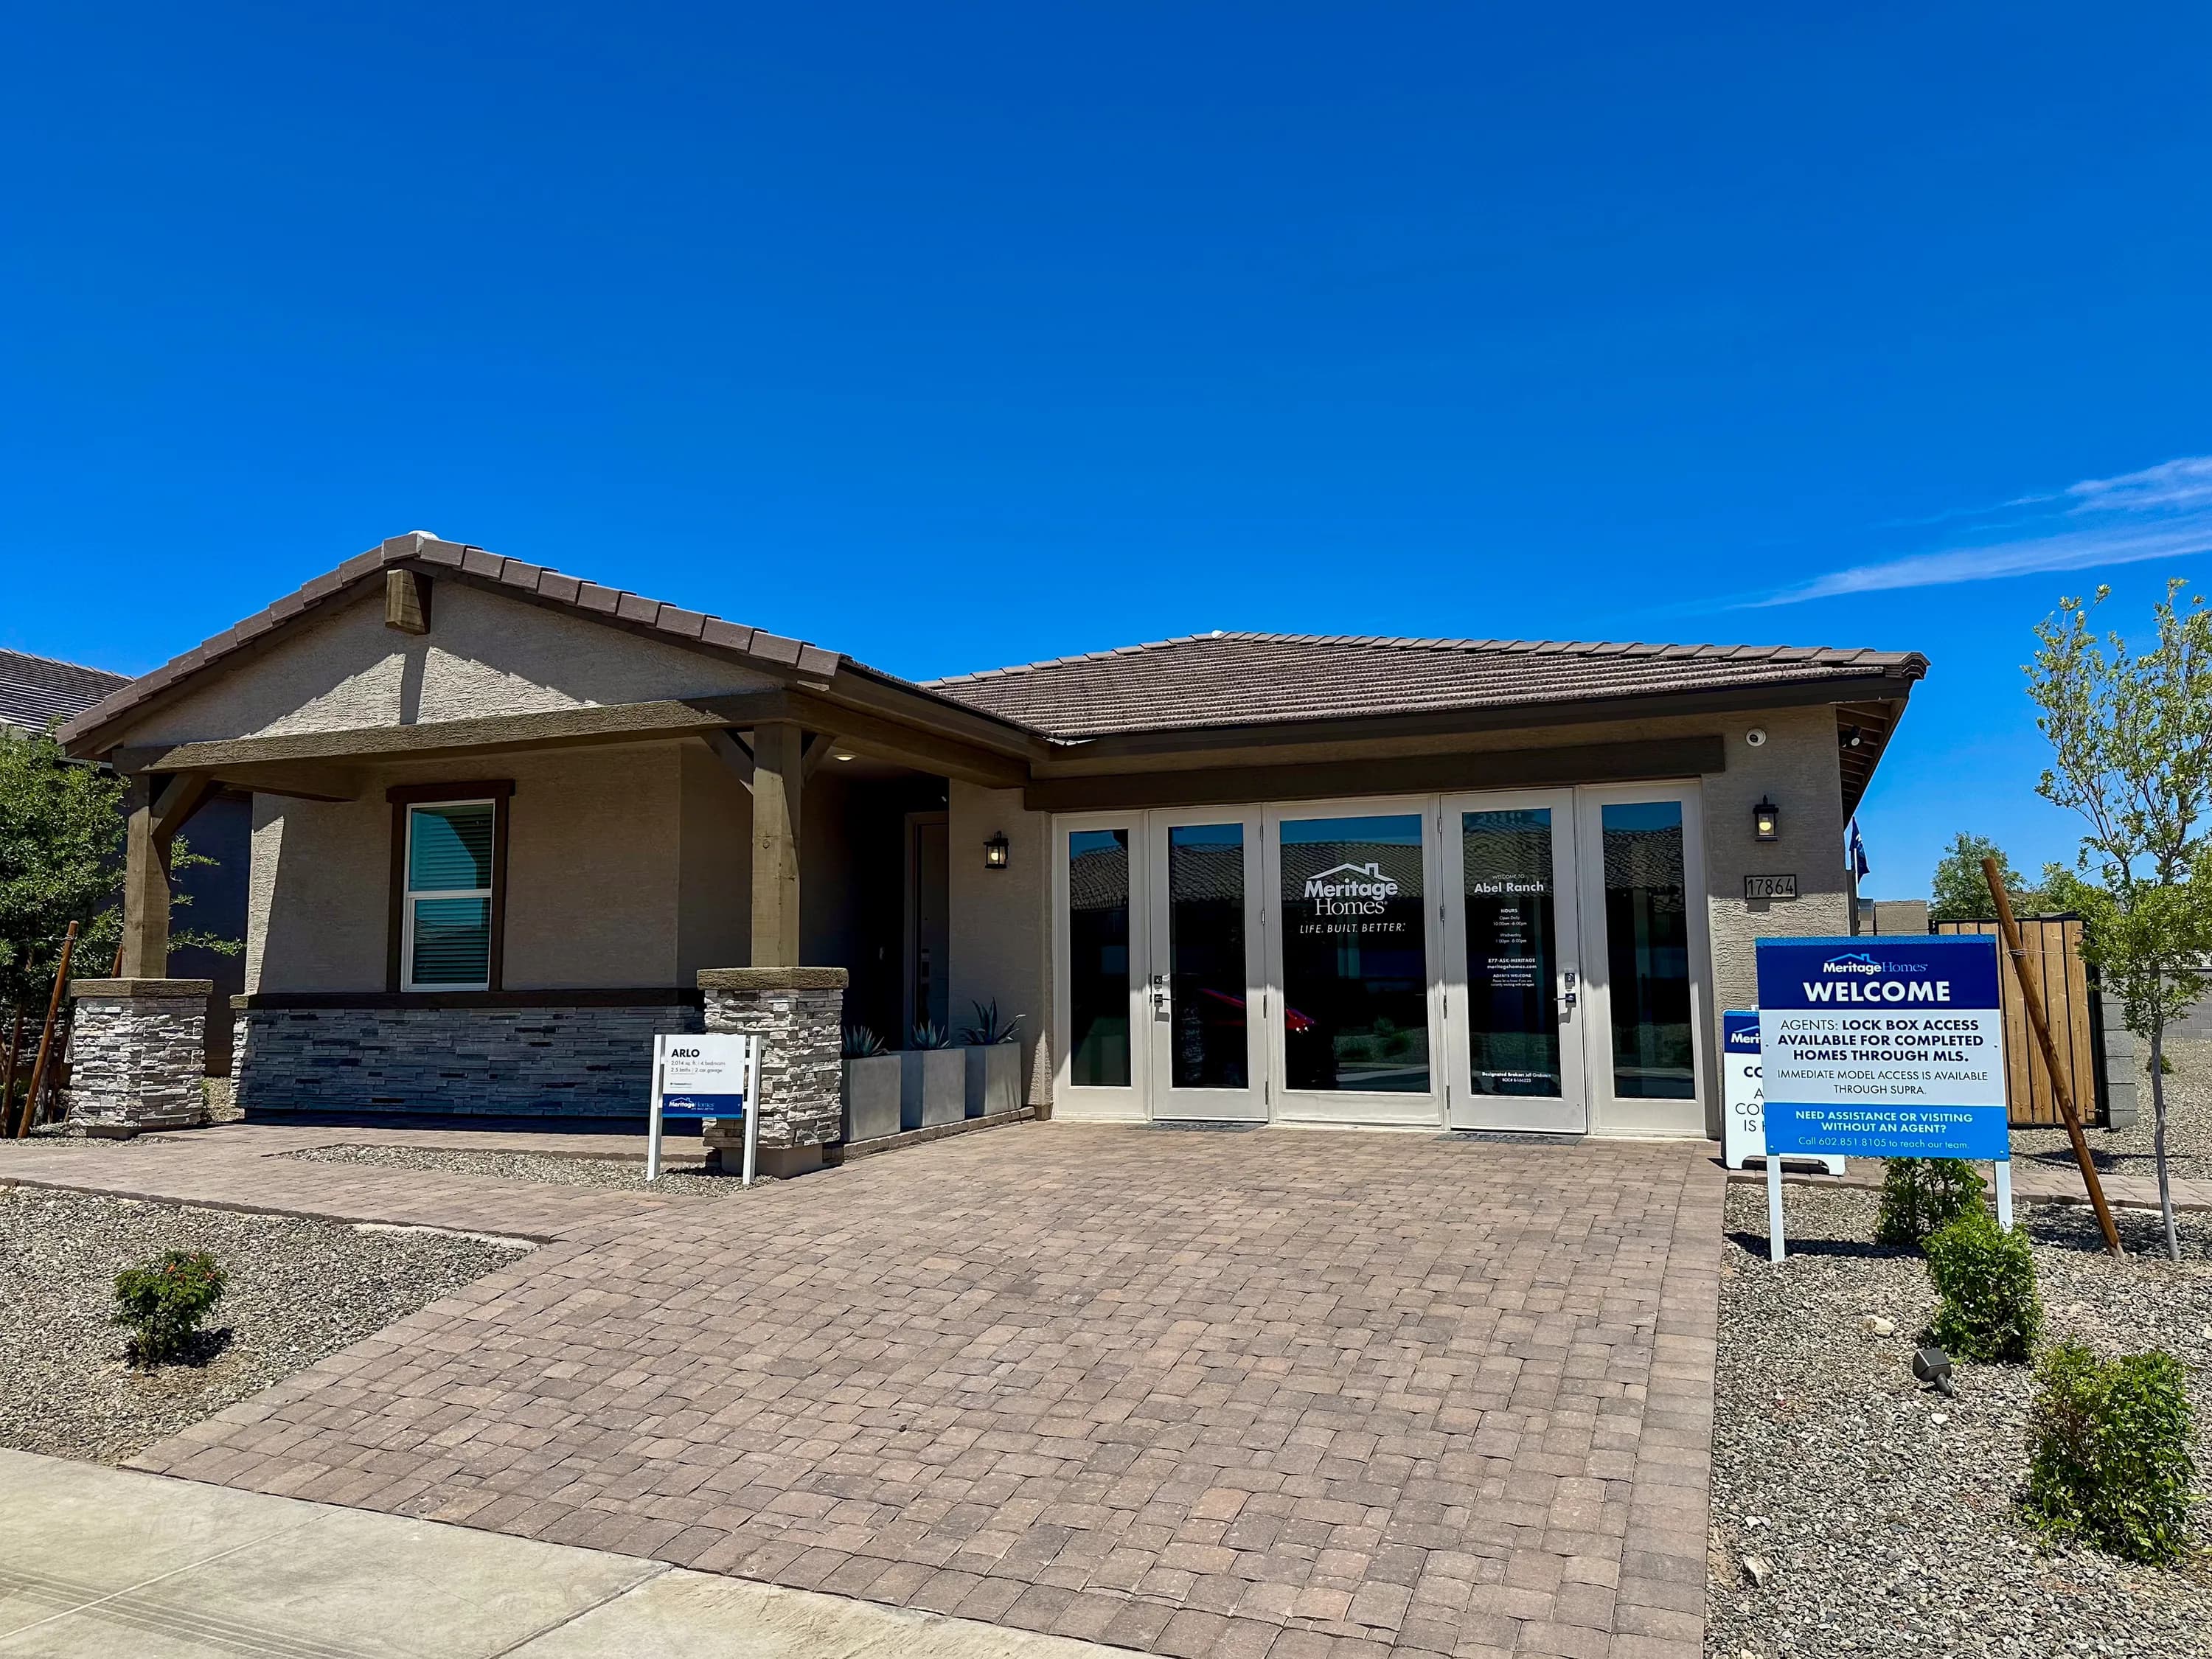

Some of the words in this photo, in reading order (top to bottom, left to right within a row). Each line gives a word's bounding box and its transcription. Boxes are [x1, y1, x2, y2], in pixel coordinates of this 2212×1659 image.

[1304, 878, 1399, 900] Meritage
[1474, 882, 1502, 893] Abel
[1506, 881, 1544, 892] Ranch
[1747, 878, 1794, 896] 17864
[1315, 898, 1388, 916] Homes
[1300, 925, 1324, 933] LIFE.
[1326, 923, 1358, 933] BUILT.
[1803, 981, 1950, 1002] WELCOME
[1781, 1019, 1838, 1031] AGENTS:
[1842, 1019, 1882, 1031] LOCK
[1886, 1020, 1919, 1031] BOX
[1923, 1020, 1979, 1031] ACCESS
[1731, 1033, 1761, 1044] Meri
[1778, 1034, 1857, 1046] AVAILABLE
[1860, 1034, 1891, 1046] FOR
[1894, 1035, 1983, 1046] COMPLETED
[671, 1048, 700, 1058] ARLO
[1793, 1049, 1847, 1061] HOMES
[1851, 1050, 1928, 1061] THROUGH
[1933, 1051, 1969, 1062] MLS.
[1778, 1070, 1834, 1079] IMMEDIATE
[1837, 1071, 1875, 1079] MODEL
[1877, 1071, 1919, 1080] ACCESS
[1922, 1071, 1931, 1080] IS
[1933, 1071, 1988, 1081] AVAILABLE
[1834, 1085, 1887, 1094] THROUGH
[1890, 1085, 1927, 1095] SUPRA.
[1795, 1110, 1825, 1119] NEED
[1828, 1111, 1897, 1121] ASSISTANCE
[1899, 1113, 1917, 1121] OR
[1920, 1113, 1973, 1122] VISITING
[1744, 1119, 1757, 1133] IS
[1821, 1121, 1876, 1132] WITHOUT
[1879, 1123, 1897, 1133] AN
[1900, 1124, 1947, 1133] AGENT?
[1798, 1136, 1816, 1145] Call
[1818, 1137, 1886, 1147] 602.851.8105
[1889, 1139, 1898, 1148] to
[1900, 1138, 1925, 1148] reach
[1945, 1141, 1970, 1150] team.
